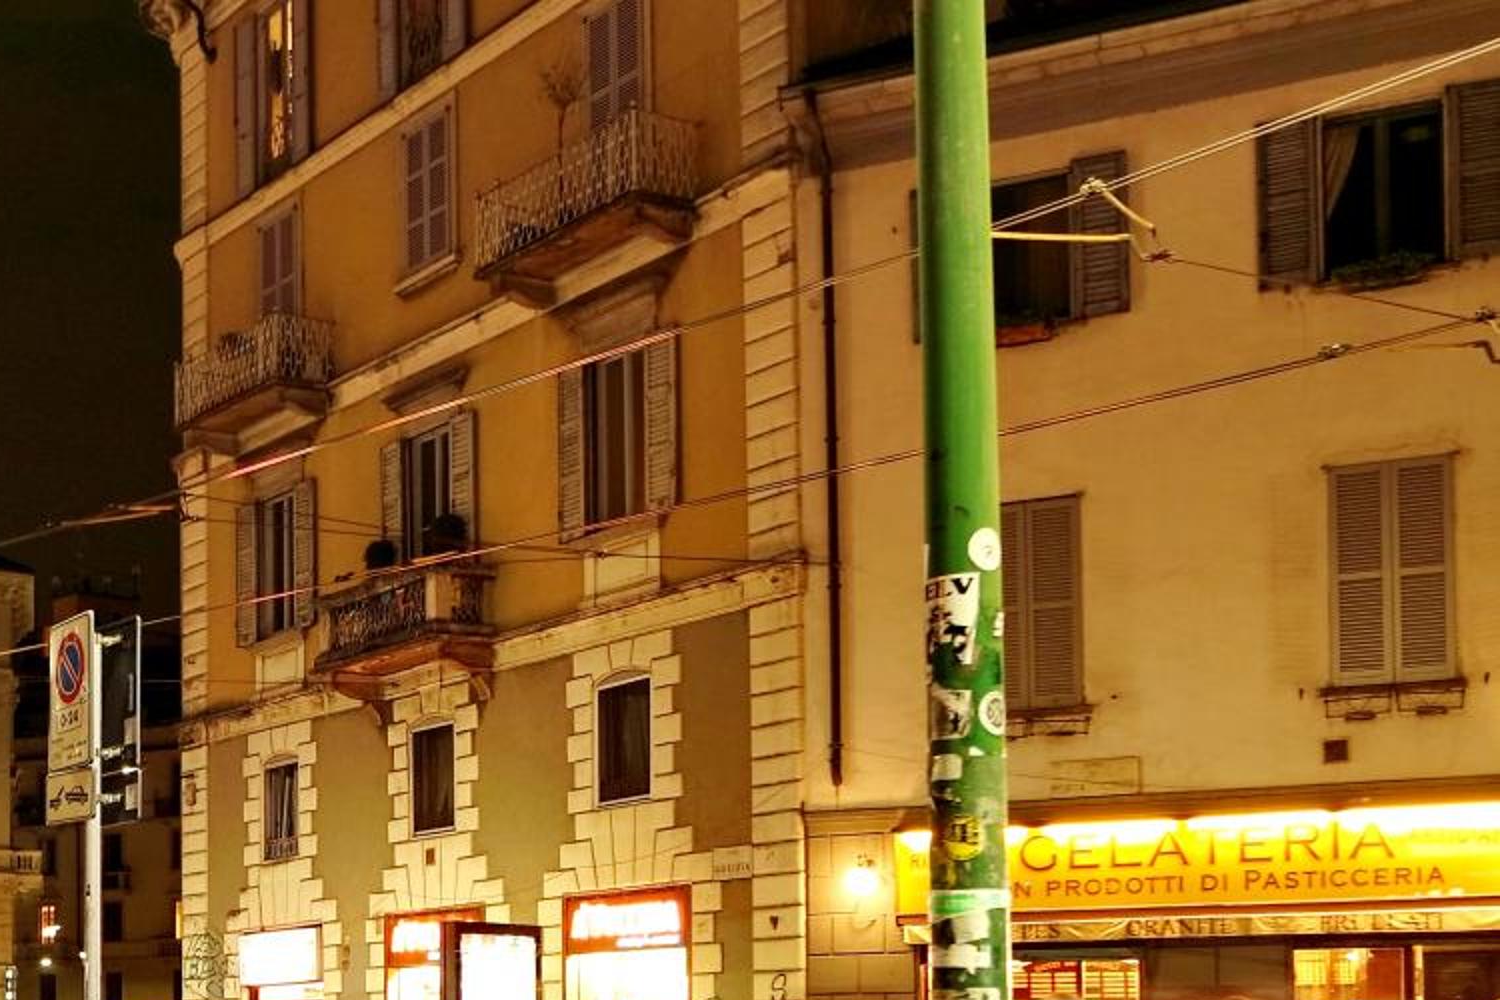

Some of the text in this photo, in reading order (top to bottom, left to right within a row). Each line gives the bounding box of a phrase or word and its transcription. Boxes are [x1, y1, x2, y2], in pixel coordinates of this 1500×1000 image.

[1020, 821, 1394, 871] GELATERIA
[1046, 875, 1185, 897] PRODOTTI
[1201, 873, 1228, 892] DI
[1244, 866, 1445, 891] PASTICCERIA
